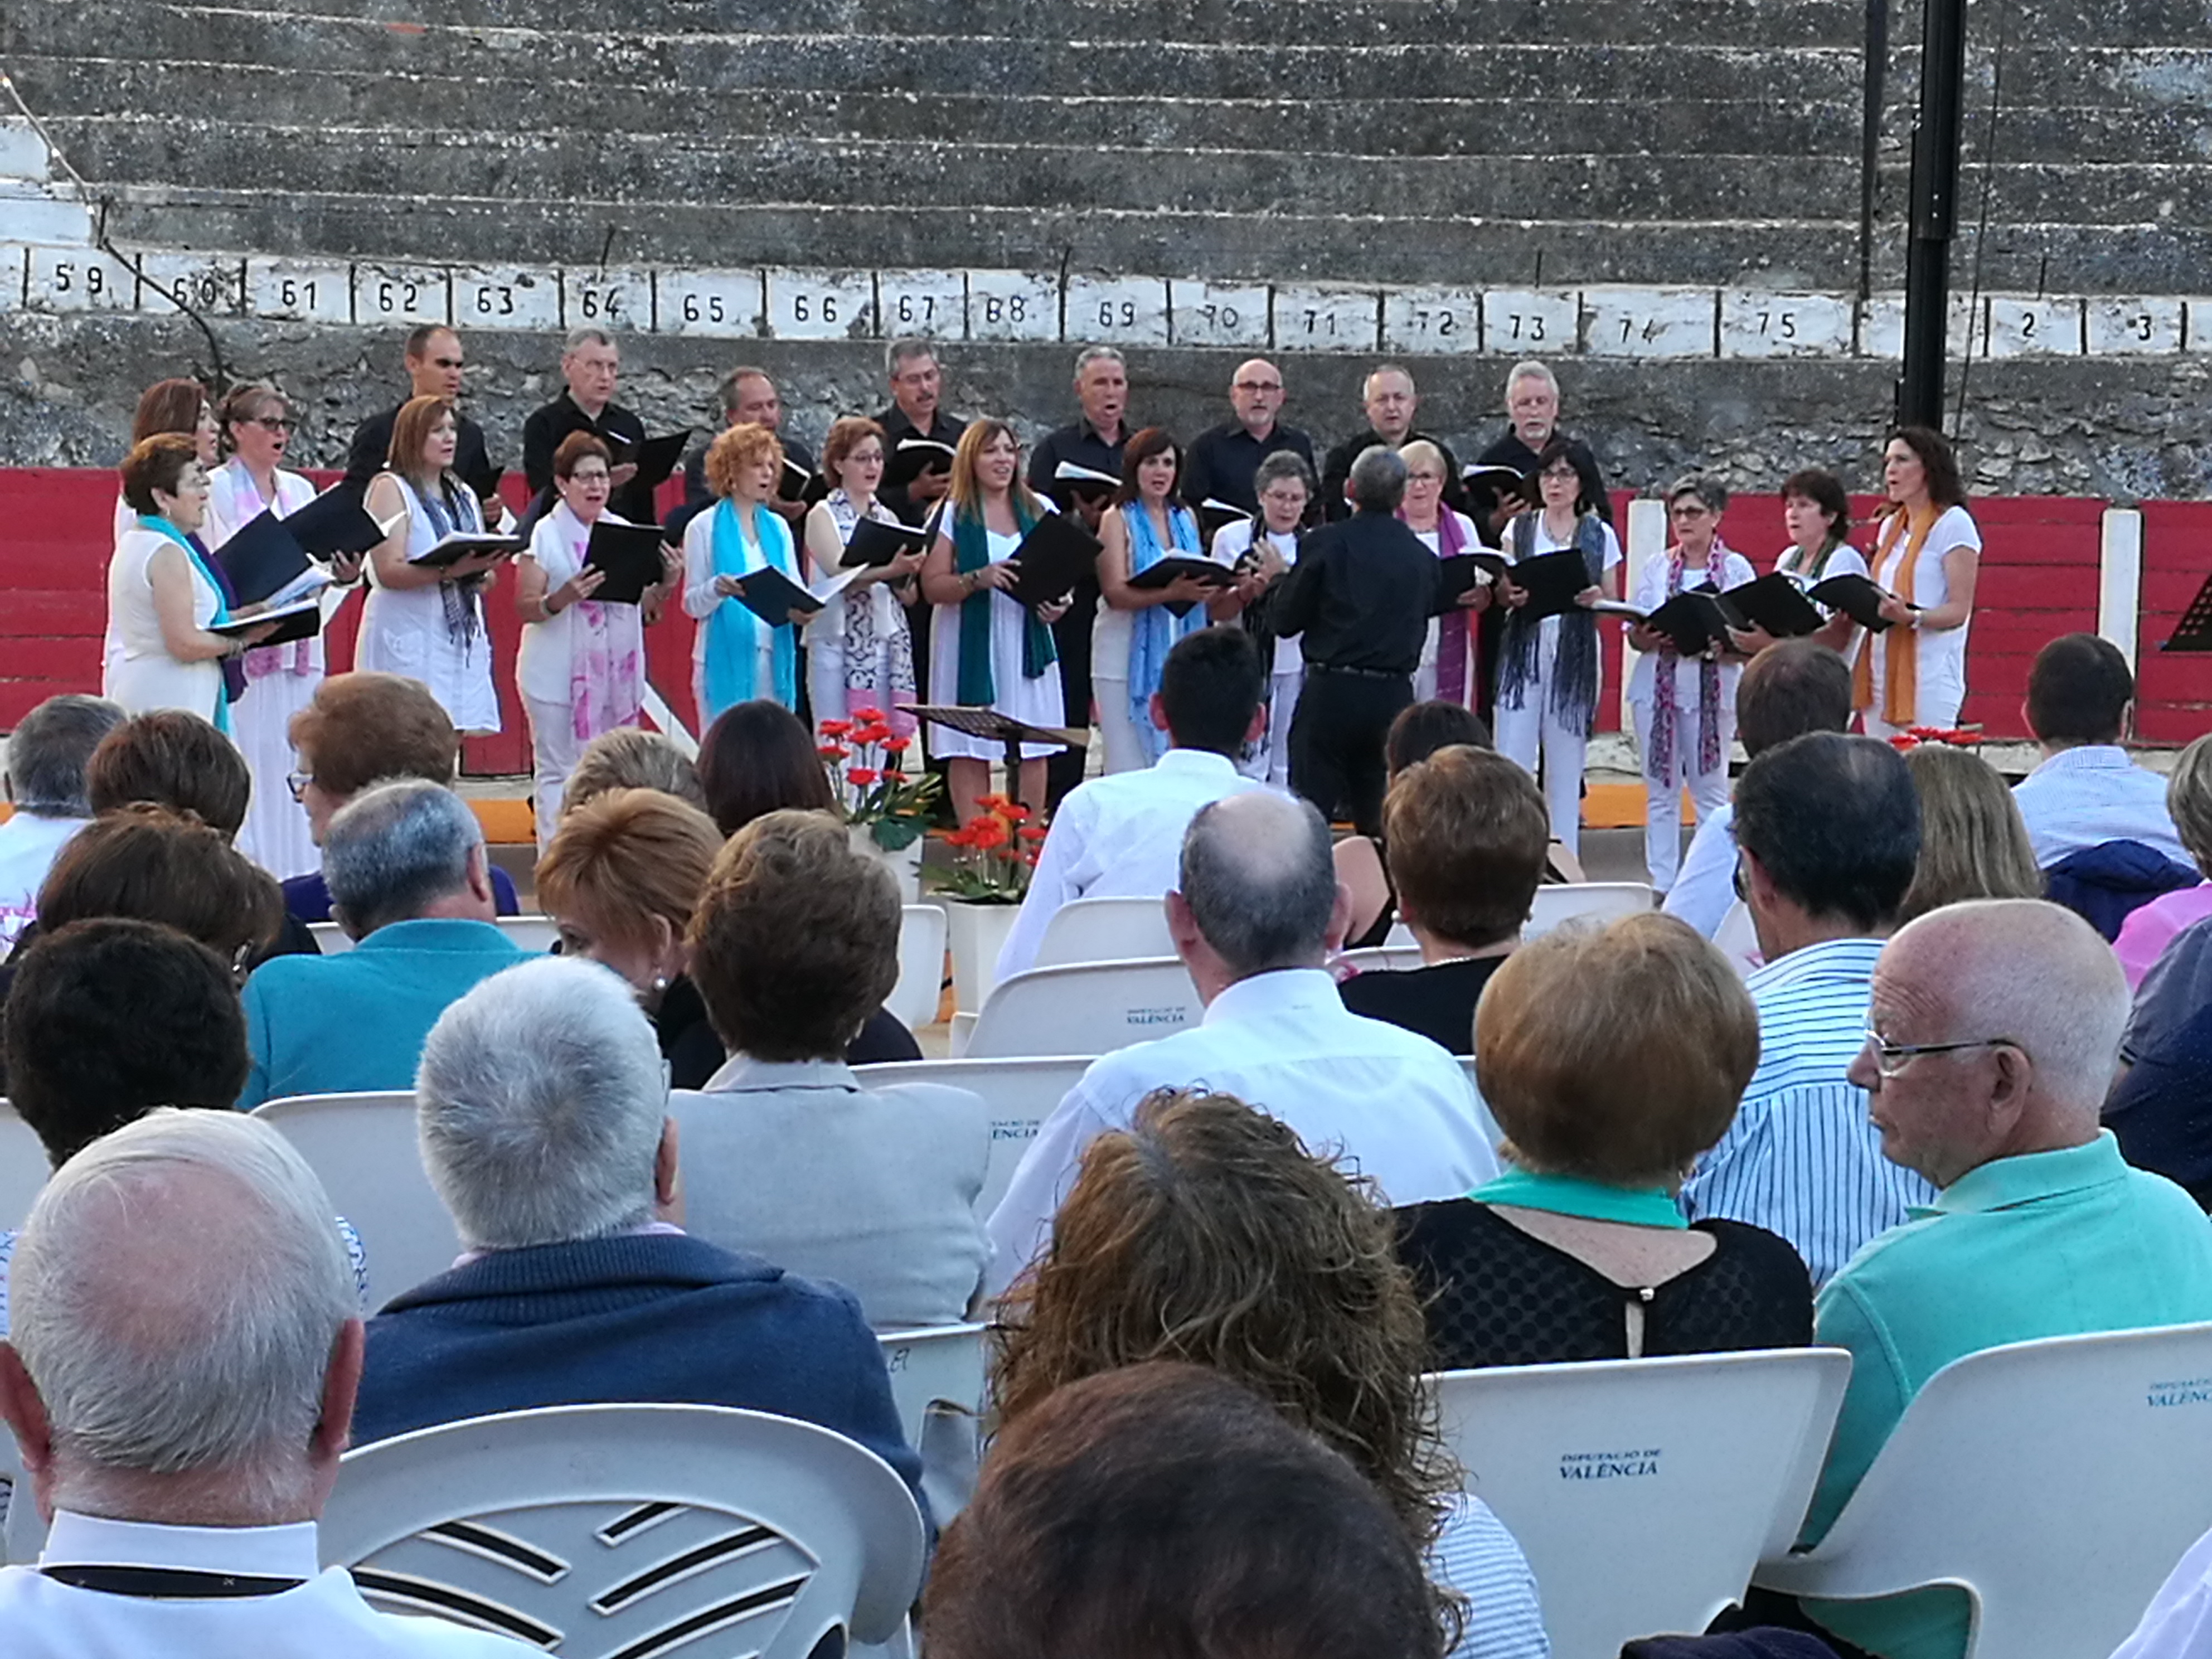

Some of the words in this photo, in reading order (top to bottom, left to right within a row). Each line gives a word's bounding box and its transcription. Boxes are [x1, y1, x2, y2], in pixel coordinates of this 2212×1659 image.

[56, 264, 103, 294] 59
[173, 278, 216, 305] 60
[282, 280, 316, 310] 61
[379, 283, 416, 312] 62
[477, 287, 513, 314] 63
[583, 288, 622, 318] 64
[684, 295, 724, 322] 65
[795, 295, 836, 322] 66
[899, 295, 934, 322] 67
[1099, 302, 1134, 327] 69
[1197, 304, 1238, 330] 70
[1304, 309, 1335, 334] 71
[1417, 311, 1453, 335] 72
[1510, 314, 1544, 341] 73
[1757, 312, 1796, 338] 75
[2022, 312, 2035, 337] 2
[1619, 318, 1657, 344] 74
[2138, 316, 2152, 341] 3
